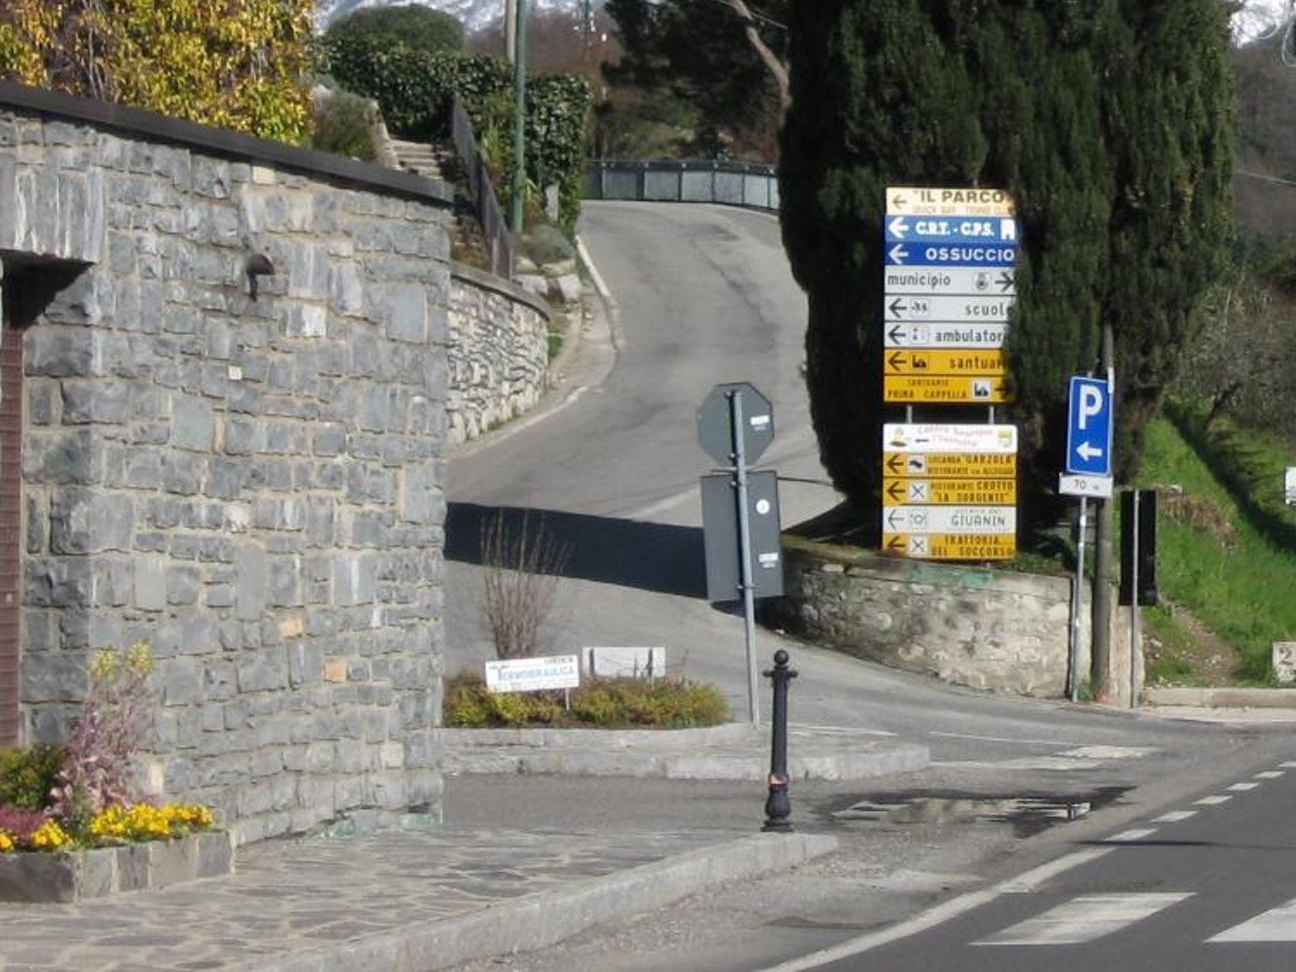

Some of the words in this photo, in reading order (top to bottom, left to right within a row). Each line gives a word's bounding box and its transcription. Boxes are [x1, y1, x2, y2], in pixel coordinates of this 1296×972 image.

[925, 247, 1015, 261] OSSUCCIO
[887, 273, 951, 290] municipio
[1078, 384, 1103, 430] P
[944, 535, 1000, 545] TRATTORIA
[958, 546, 1013, 557] SOCCORSO
